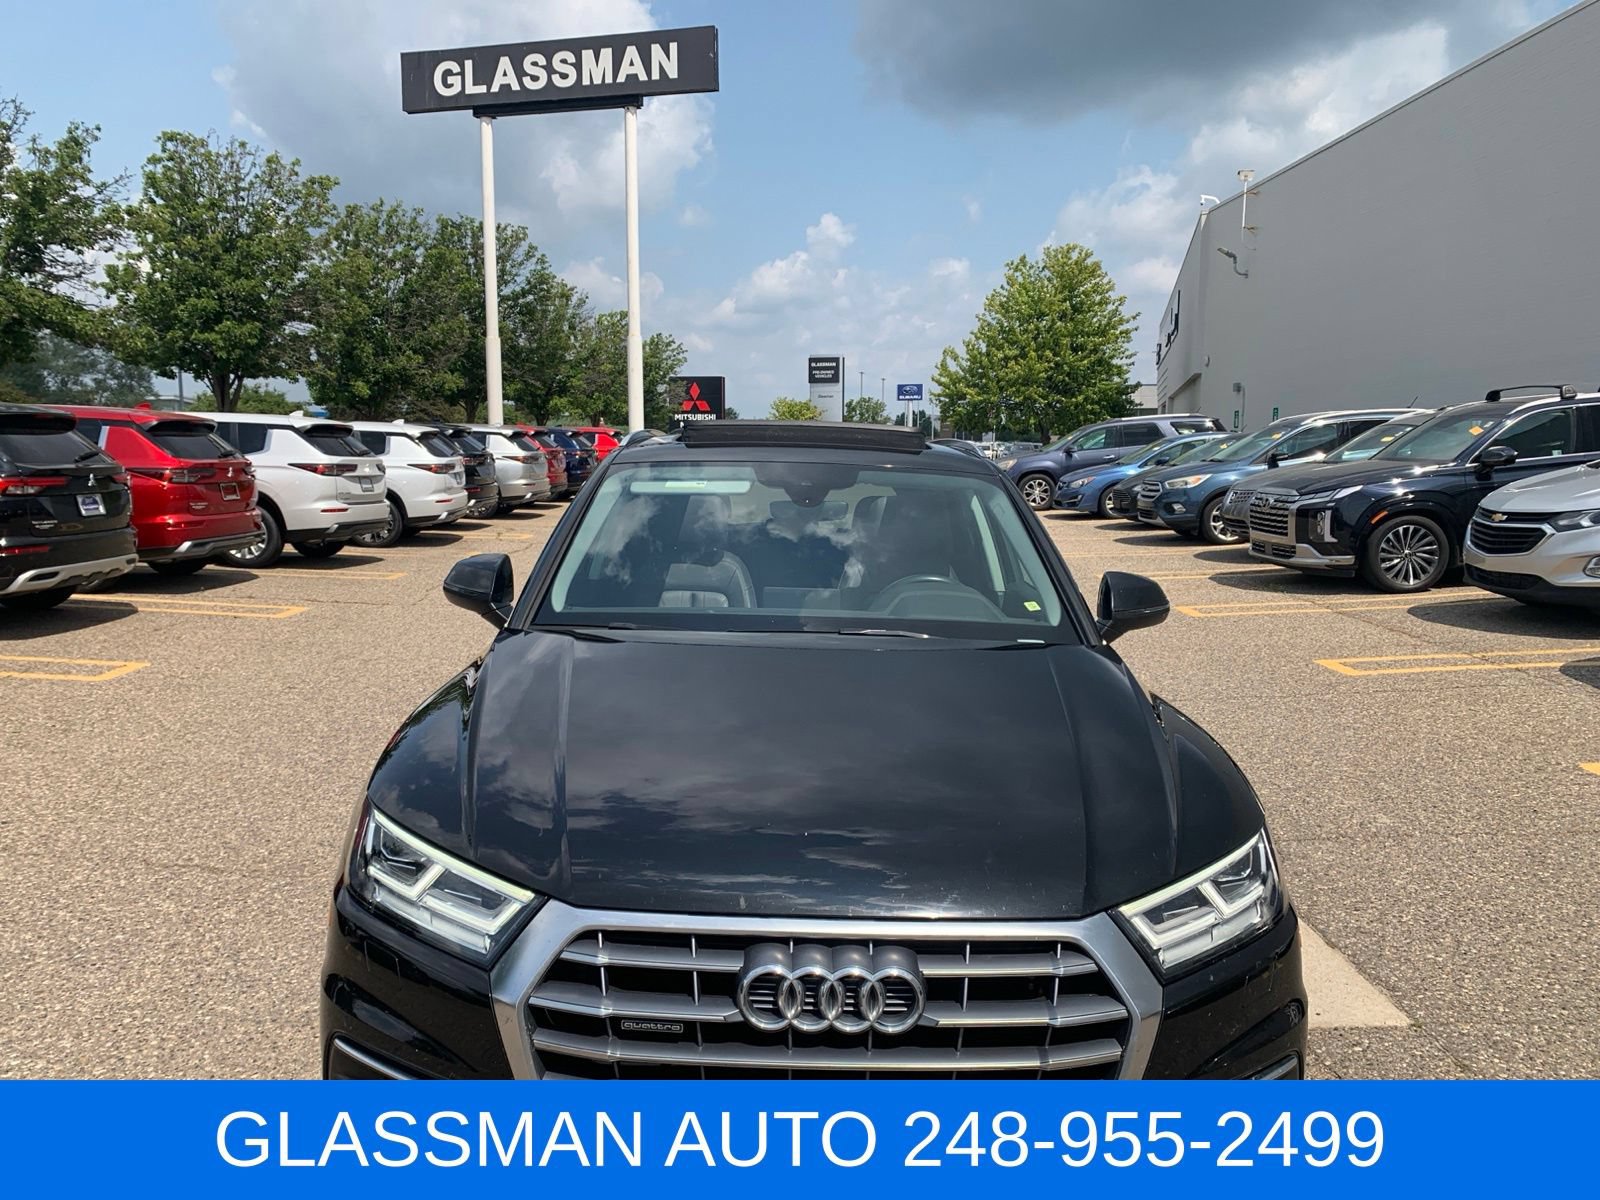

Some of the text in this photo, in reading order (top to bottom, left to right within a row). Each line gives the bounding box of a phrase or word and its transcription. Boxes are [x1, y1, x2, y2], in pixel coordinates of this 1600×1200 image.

[433, 41, 679, 97] GLASSMAN
[674, 413, 717, 421] MITSUBISHI
[623, 1022, 681, 1031] quattro
